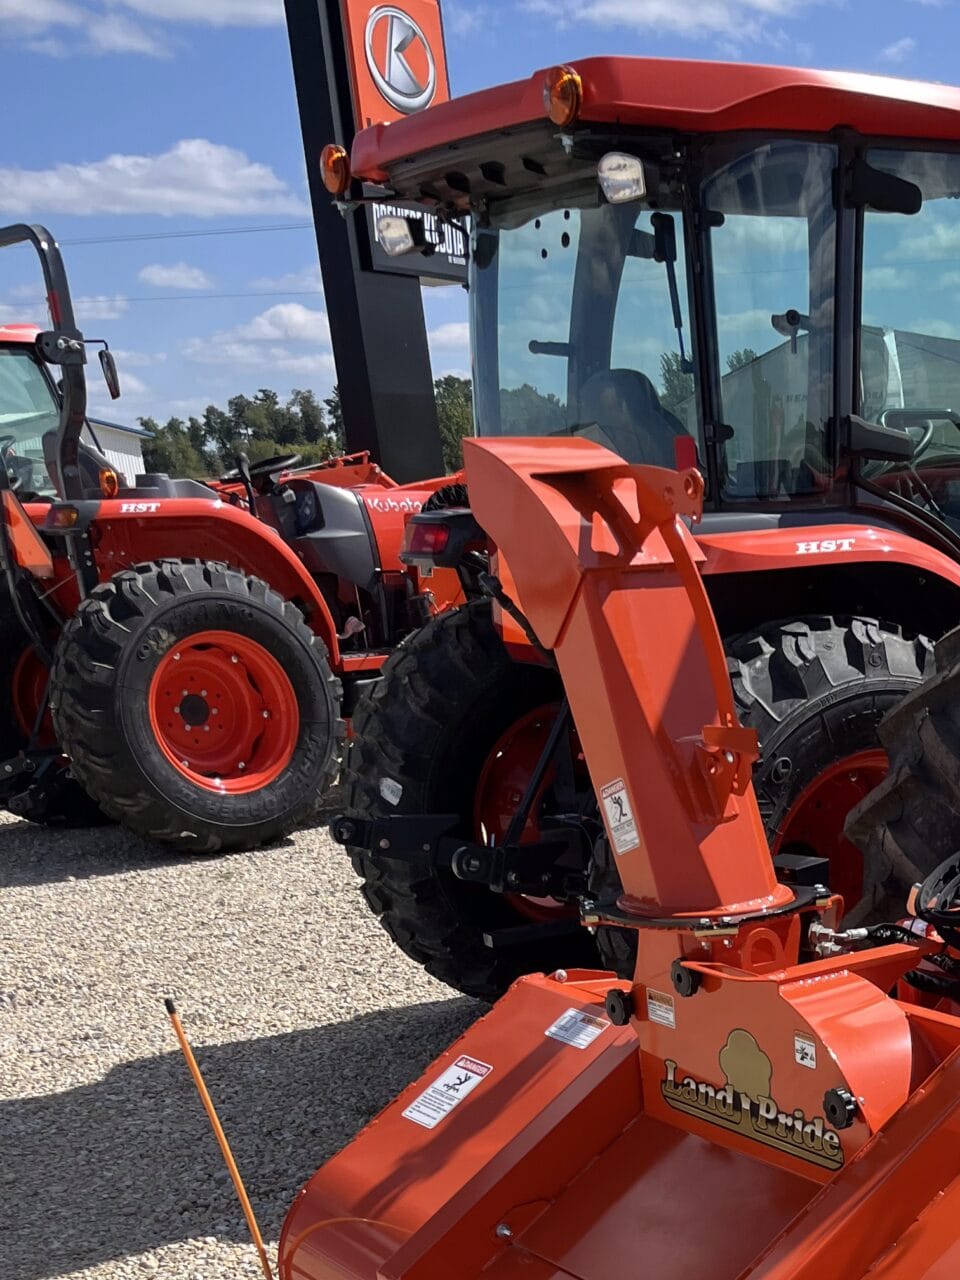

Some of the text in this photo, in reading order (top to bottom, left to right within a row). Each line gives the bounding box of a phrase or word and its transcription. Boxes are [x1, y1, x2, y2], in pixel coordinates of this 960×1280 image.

[120, 502, 161, 513] HST
[367, 497, 422, 512] Kubota
[795, 538, 856, 555] HST
[663, 1059, 841, 1157] Land Pride
